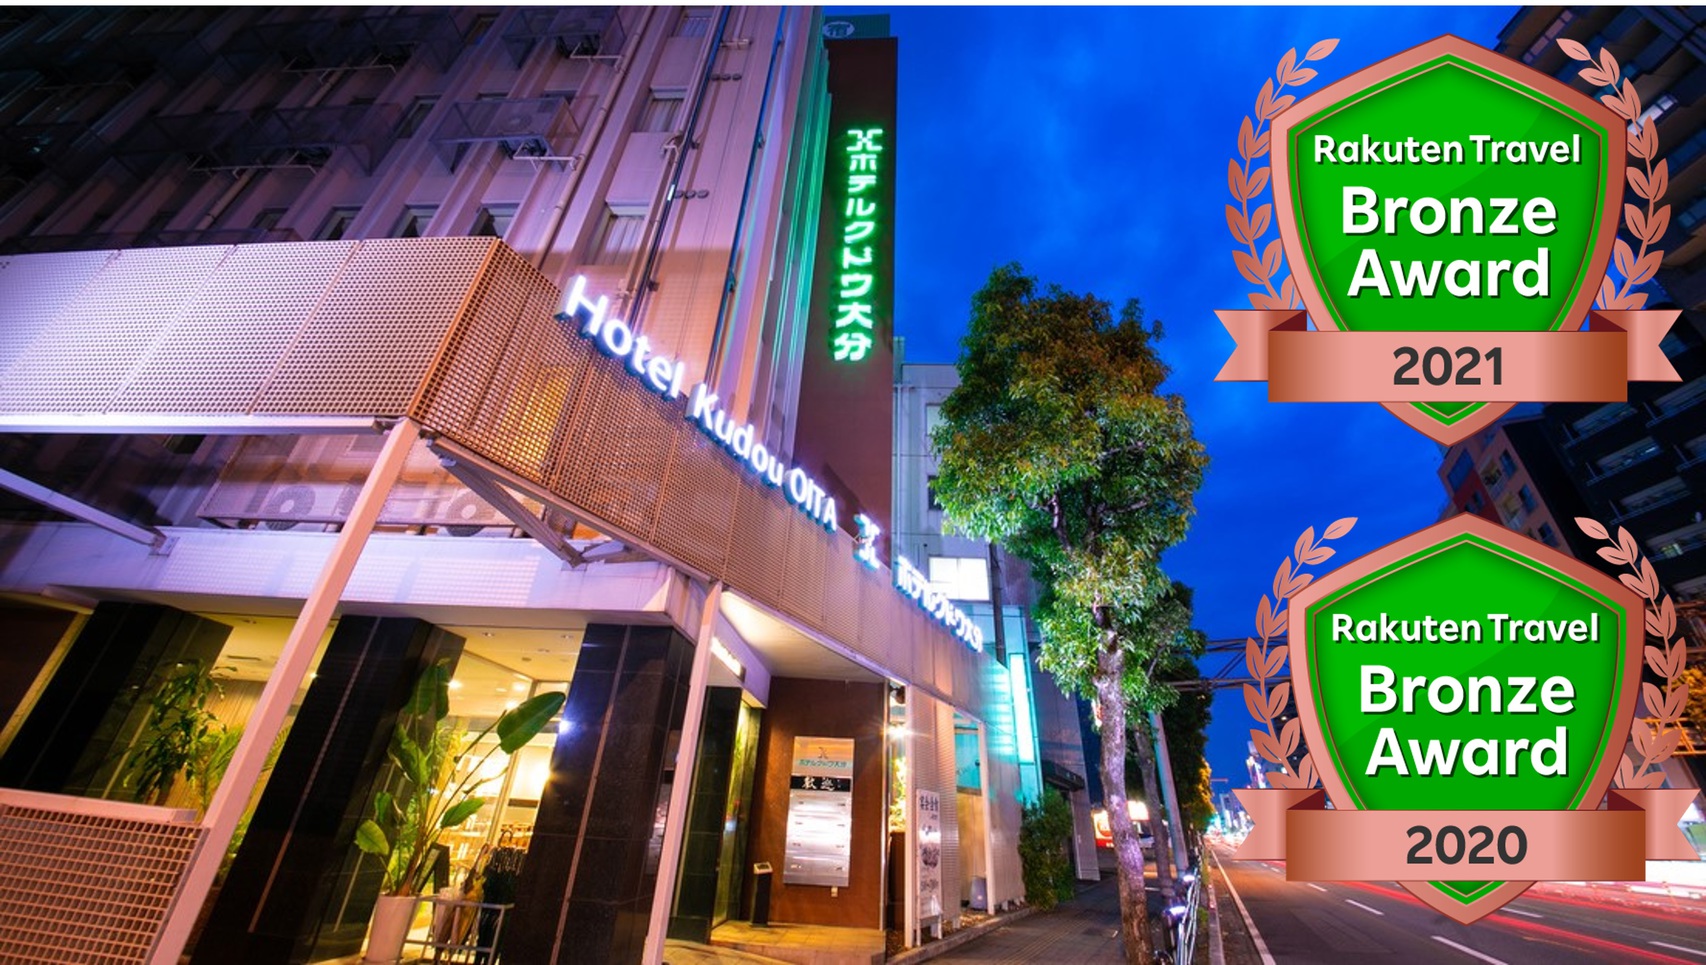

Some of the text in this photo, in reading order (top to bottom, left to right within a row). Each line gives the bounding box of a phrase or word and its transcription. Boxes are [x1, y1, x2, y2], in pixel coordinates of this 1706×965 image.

[834, 154, 877, 362] ホテルクドウ大分
[563, 275, 838, 533] Hotel Kudou OITA
